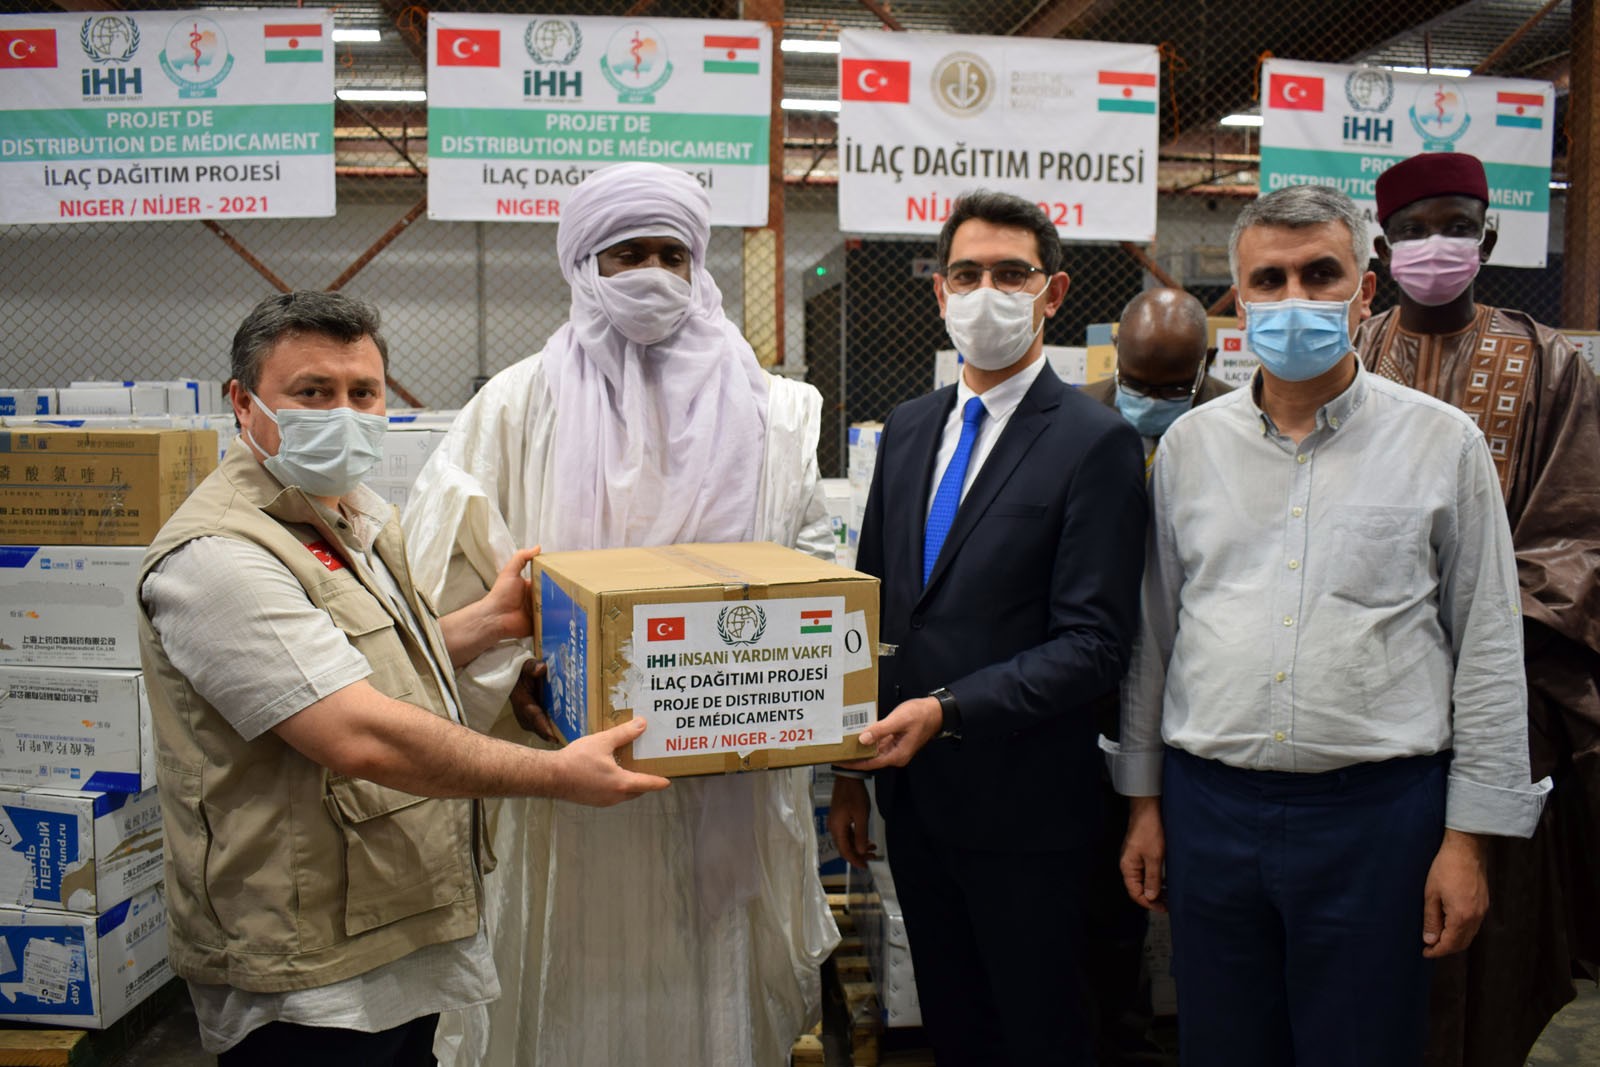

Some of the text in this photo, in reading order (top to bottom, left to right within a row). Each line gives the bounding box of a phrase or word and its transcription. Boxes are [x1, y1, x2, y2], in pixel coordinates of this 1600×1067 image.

[107, 110, 213, 128] PROJET DE
[546, 114, 650, 133] PROJET DE
[2, 131, 320, 156] DISTRIBUTION DE MÉDICAMENT
[441, 136, 753, 160] DISTRIBUTION DE MÉDICAMENT
[846, 138, 1144, 183] İLAÇ DAĞITIM PROJESİ
[1361, 157, 1395, 173] PRO
[44, 161, 281, 189] İLAÇ DAĞITIM PROJESİ
[483, 164, 593, 188] İLAÇ DAĞI
[1269, 172, 1376, 195] DISTRIBUTIO
[60, 199, 126, 217] NIGER
[130, 198, 136, 215] /
[143, 194, 201, 215] NİJER
[219, 196, 268, 214] 2021
[497, 199, 560, 216] NIGER
[907, 192, 951, 222] NİJ
[732, 647, 788, 664] YARDIM
[791, 645, 832, 661] VAKFI
[651, 667, 828, 692] İLAÇ DAĞITIMI PROJESİ
[654, 689, 825, 712] PROJE DE DISTRIBUTION
[676, 708, 804, 729] DE MÉDICAMENTS
[666, 733, 708, 751] NİJER
[721, 732, 767, 748] NIGER
[779, 728, 814, 743] 2021
[37, 822, 51, 890] ПЕРВЫЙ
